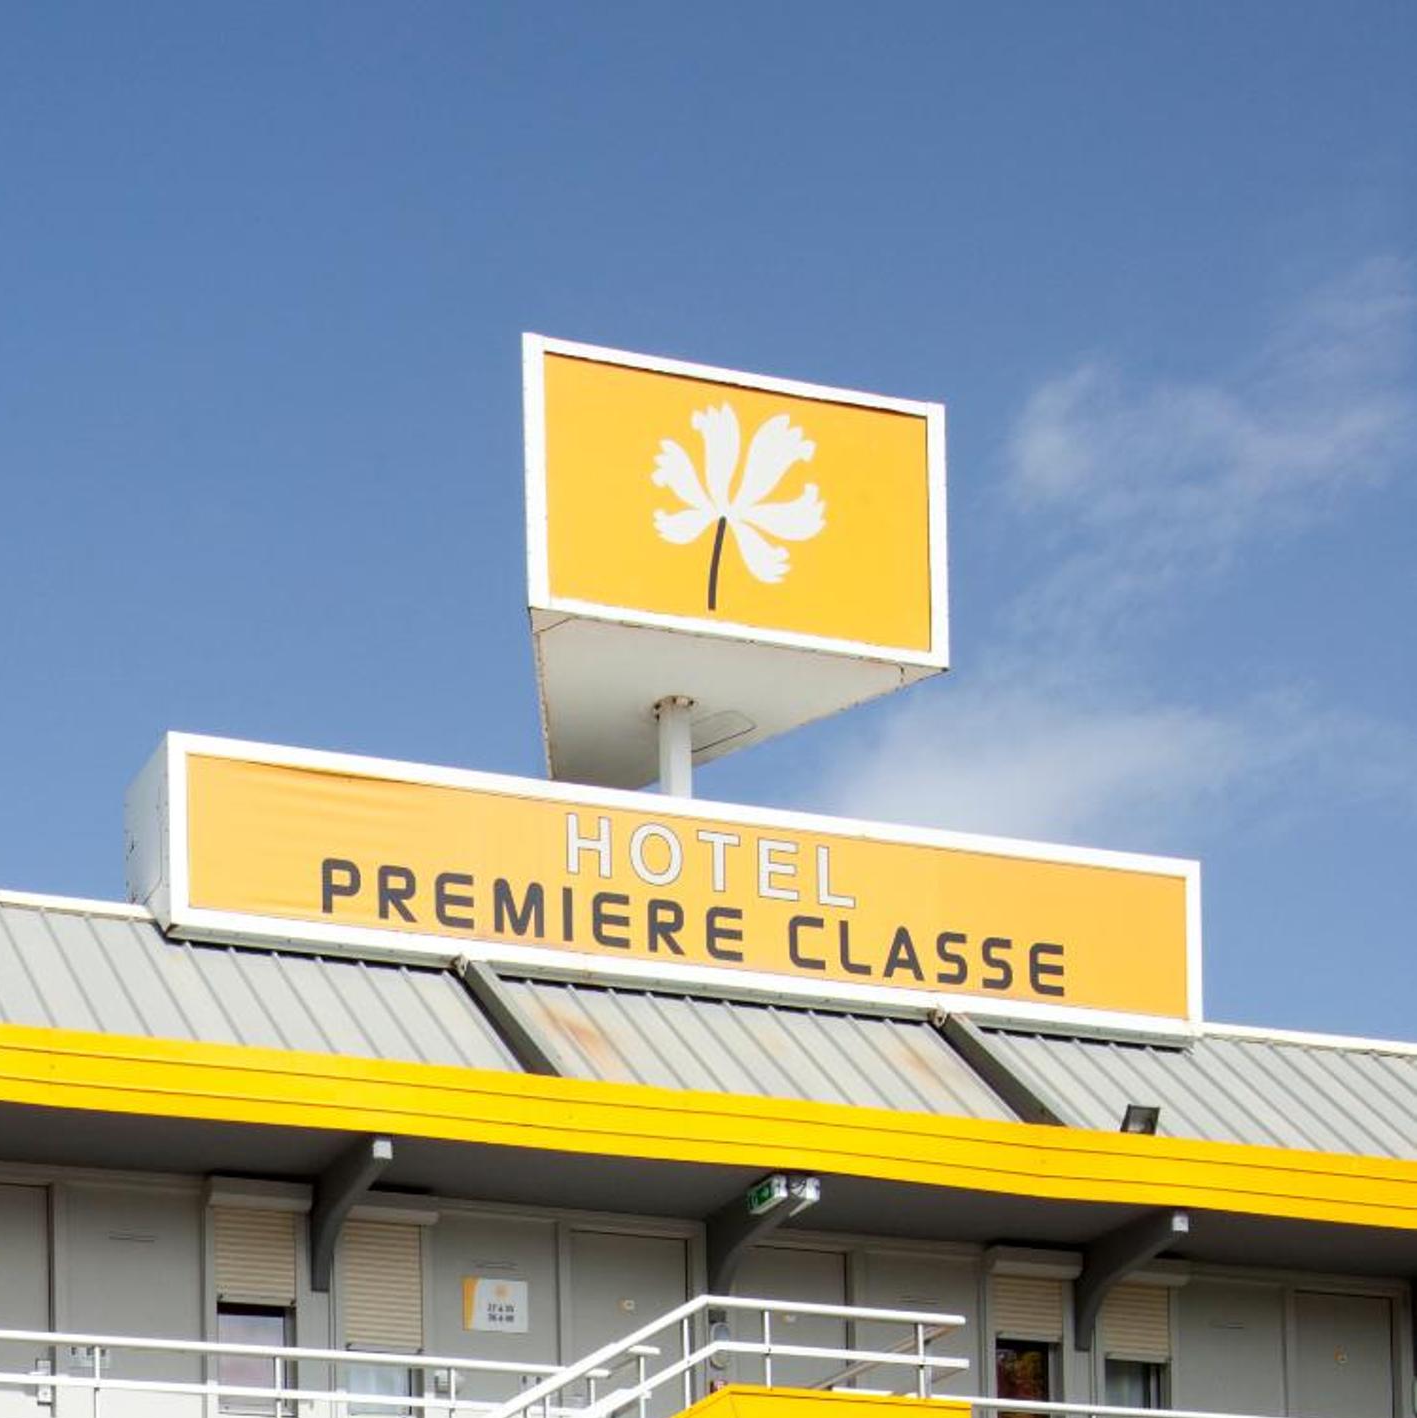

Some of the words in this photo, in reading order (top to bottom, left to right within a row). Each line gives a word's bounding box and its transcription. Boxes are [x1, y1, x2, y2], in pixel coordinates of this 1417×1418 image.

[566, 811, 855, 908] HOTEL
[322, 858, 743, 962] PREMIERE
[789, 915, 1064, 997] CLASSE
